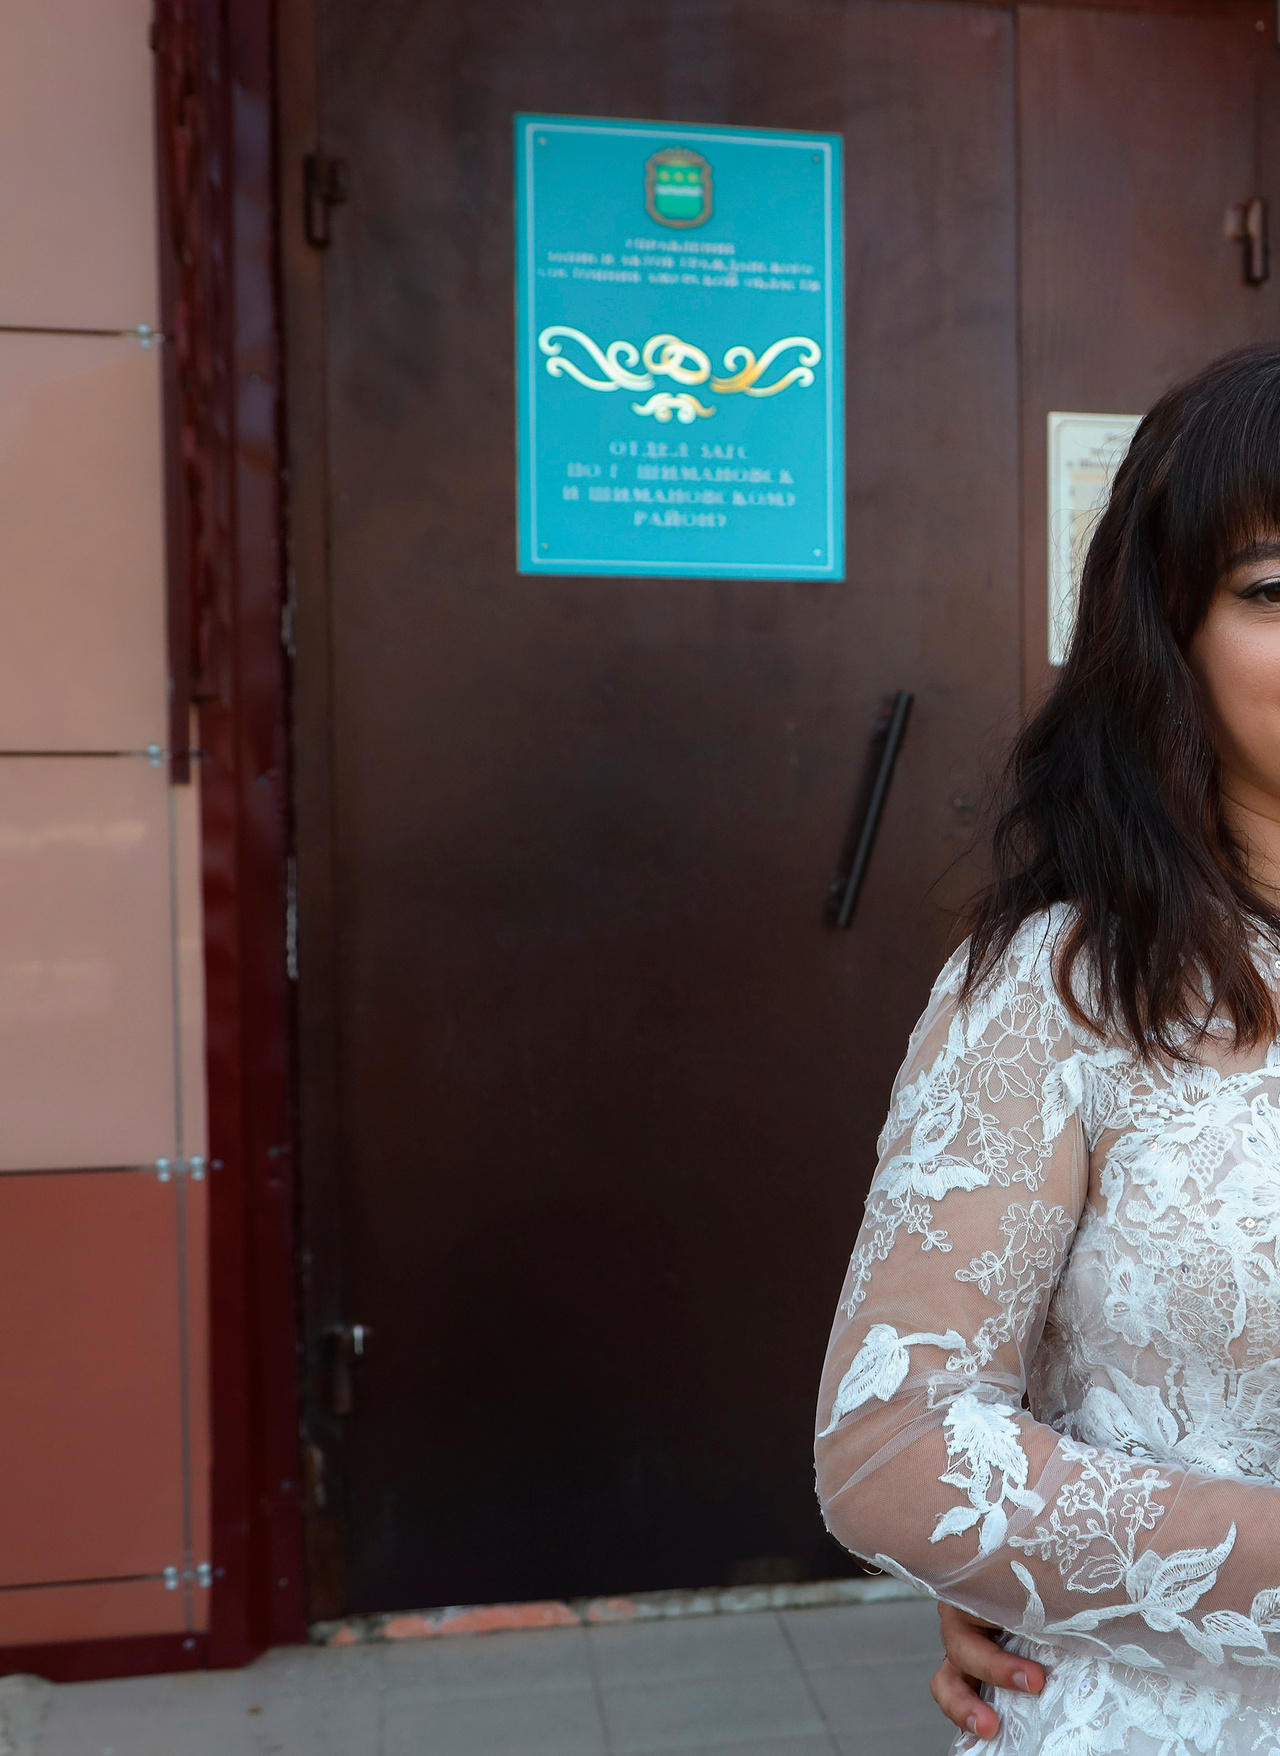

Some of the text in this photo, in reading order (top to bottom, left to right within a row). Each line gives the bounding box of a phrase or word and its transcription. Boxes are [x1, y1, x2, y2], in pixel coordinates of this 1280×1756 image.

[566, 461, 602, 479] ПО
[561, 484, 581, 502] И
[632, 508, 729, 528] РАЙОНУ
